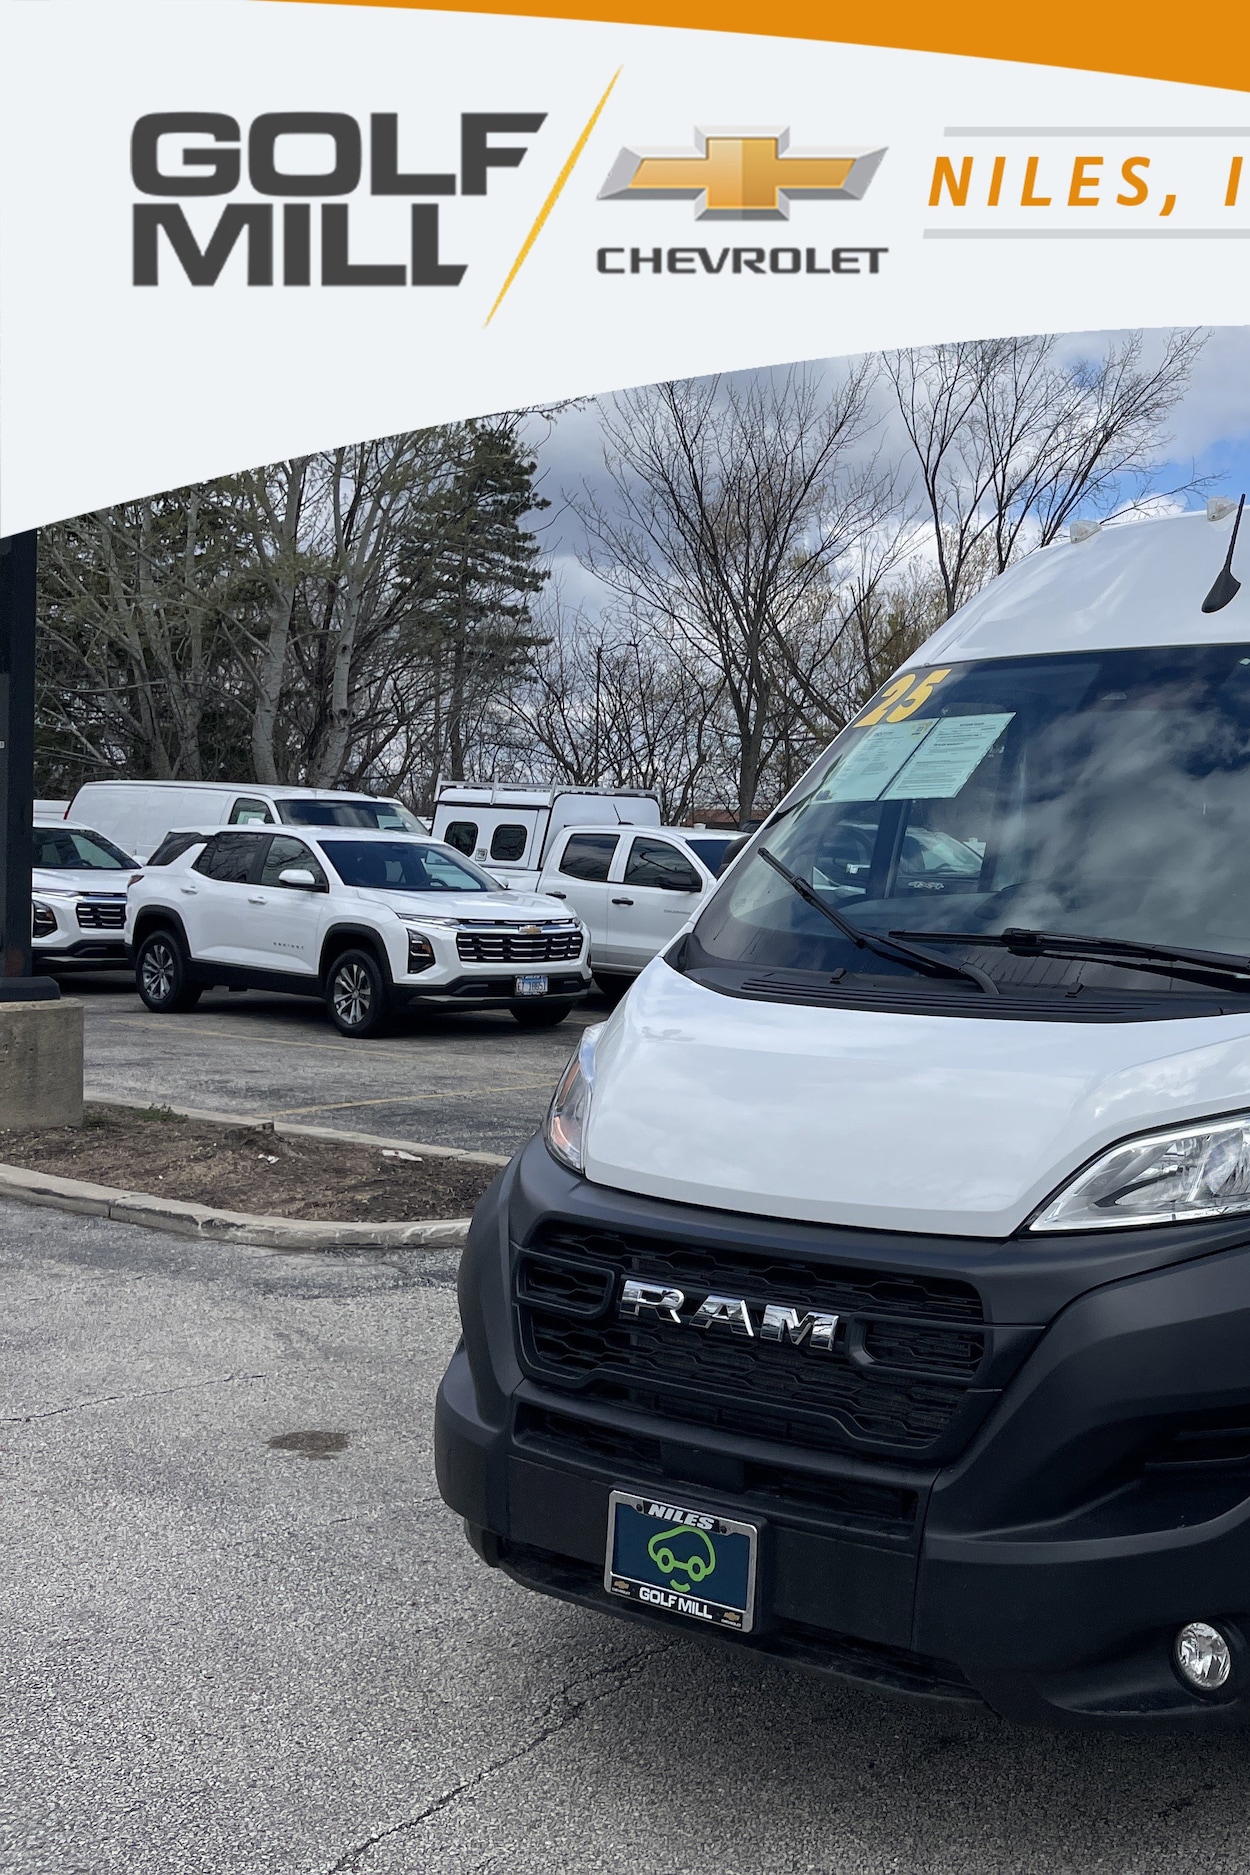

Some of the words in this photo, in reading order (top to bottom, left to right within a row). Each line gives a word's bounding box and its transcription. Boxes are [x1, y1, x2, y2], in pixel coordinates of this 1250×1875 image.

[853, 669, 952, 728] 25
[620, 1279, 840, 1351] RAM
[647, 1503, 715, 1530] NILES
[639, 1586, 677, 1608] GOLF
[678, 1597, 713, 1620] MILL
